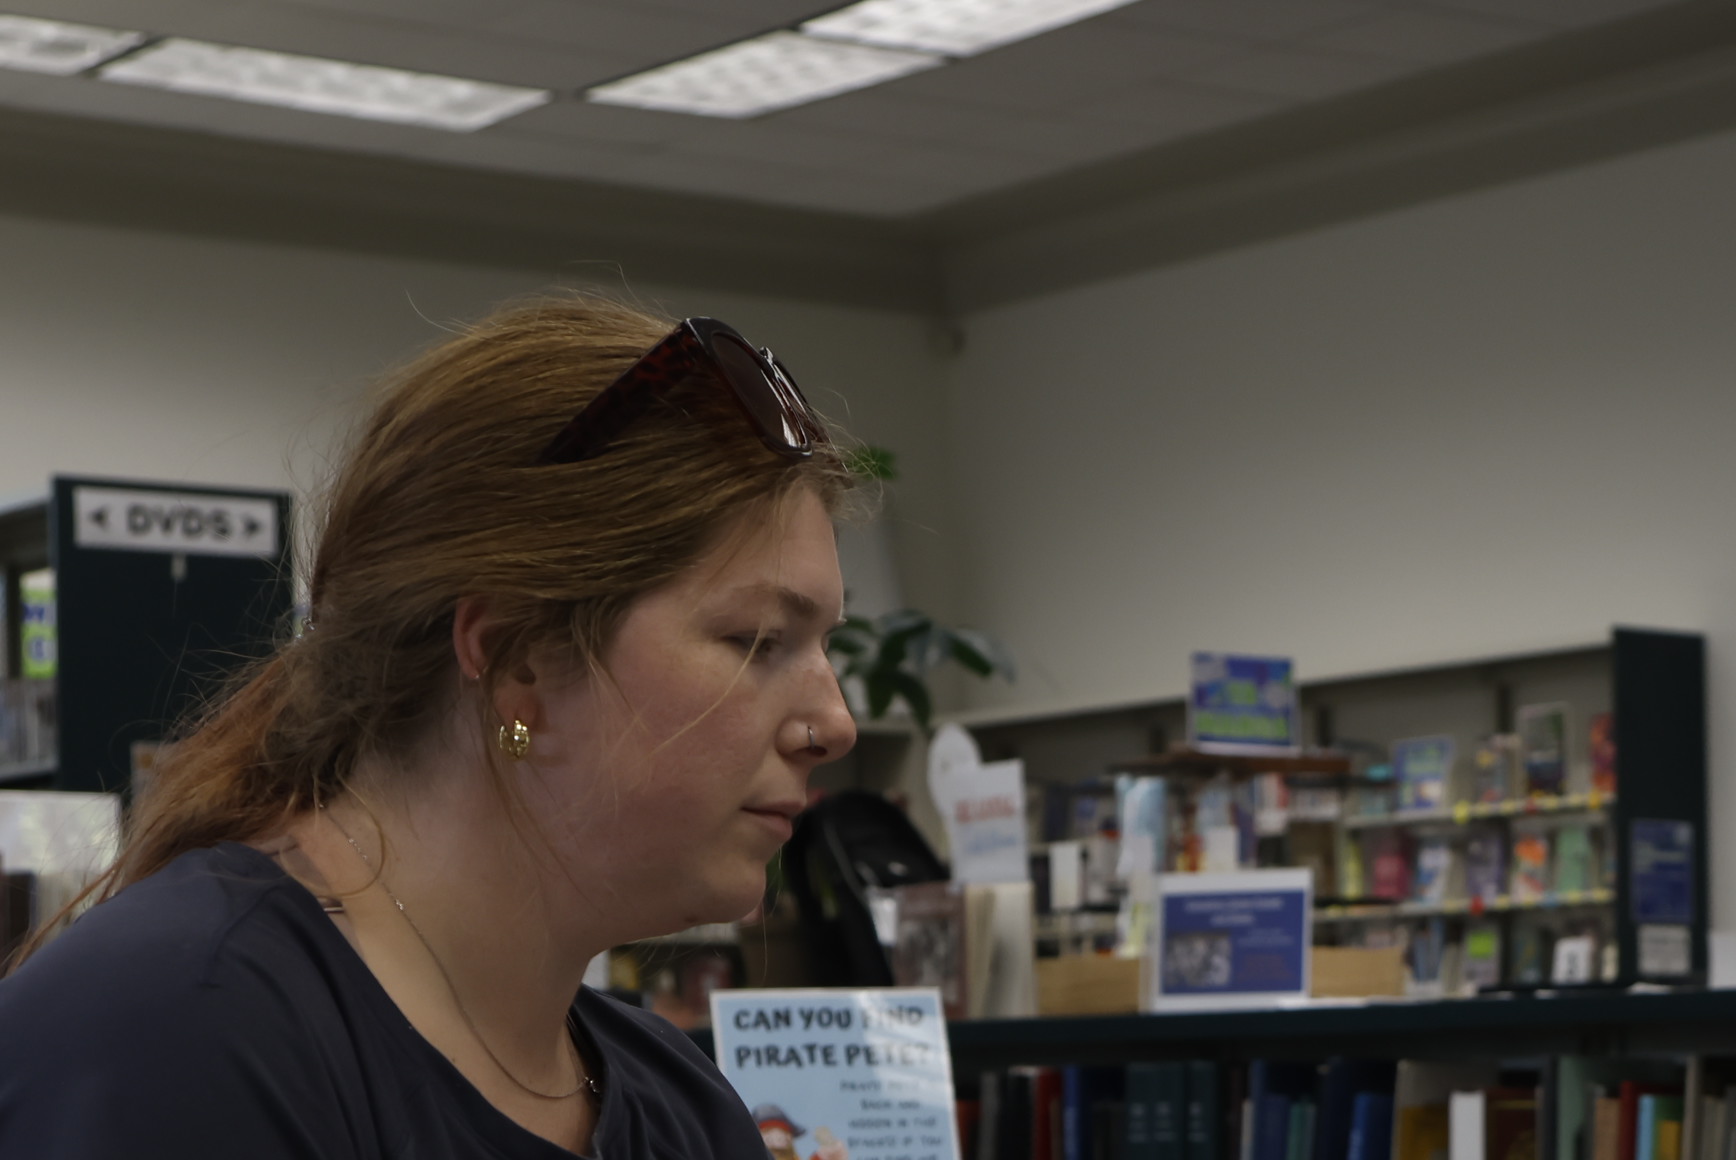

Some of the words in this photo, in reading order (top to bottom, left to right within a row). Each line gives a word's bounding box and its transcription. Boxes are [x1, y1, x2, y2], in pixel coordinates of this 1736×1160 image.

[128, 504, 233, 537] DVDS
[734, 1006, 792, 1031] CAN
[799, 1006, 853, 1030] YOU
[735, 1043, 838, 1069] PIRATE
